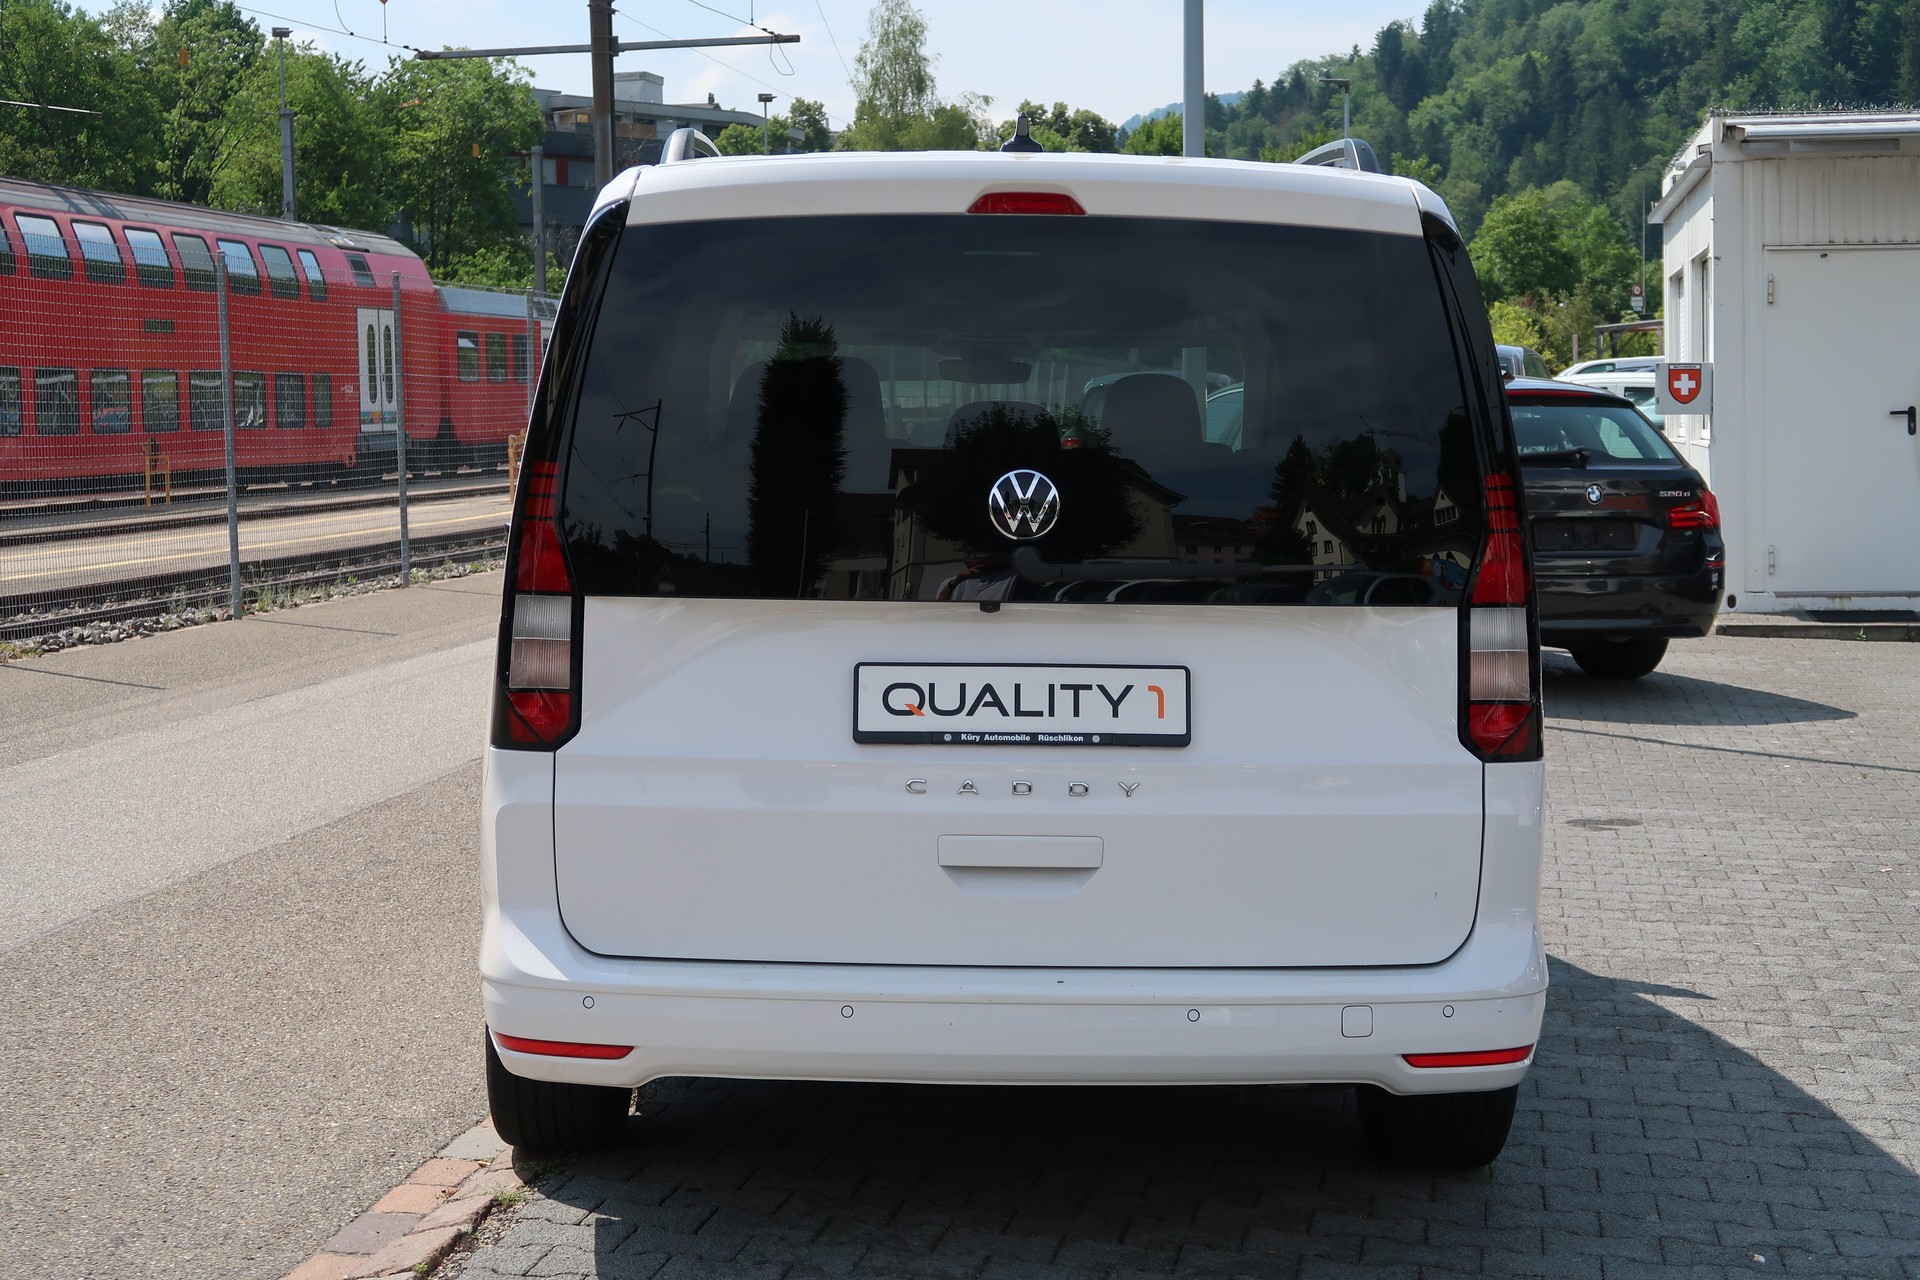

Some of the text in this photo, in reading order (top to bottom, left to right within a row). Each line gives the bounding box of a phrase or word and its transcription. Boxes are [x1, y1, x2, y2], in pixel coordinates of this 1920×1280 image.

[960, 733, 1084, 742] Küry Automobile Rüschlikon
[905, 778, 1140, 798] CADDY
